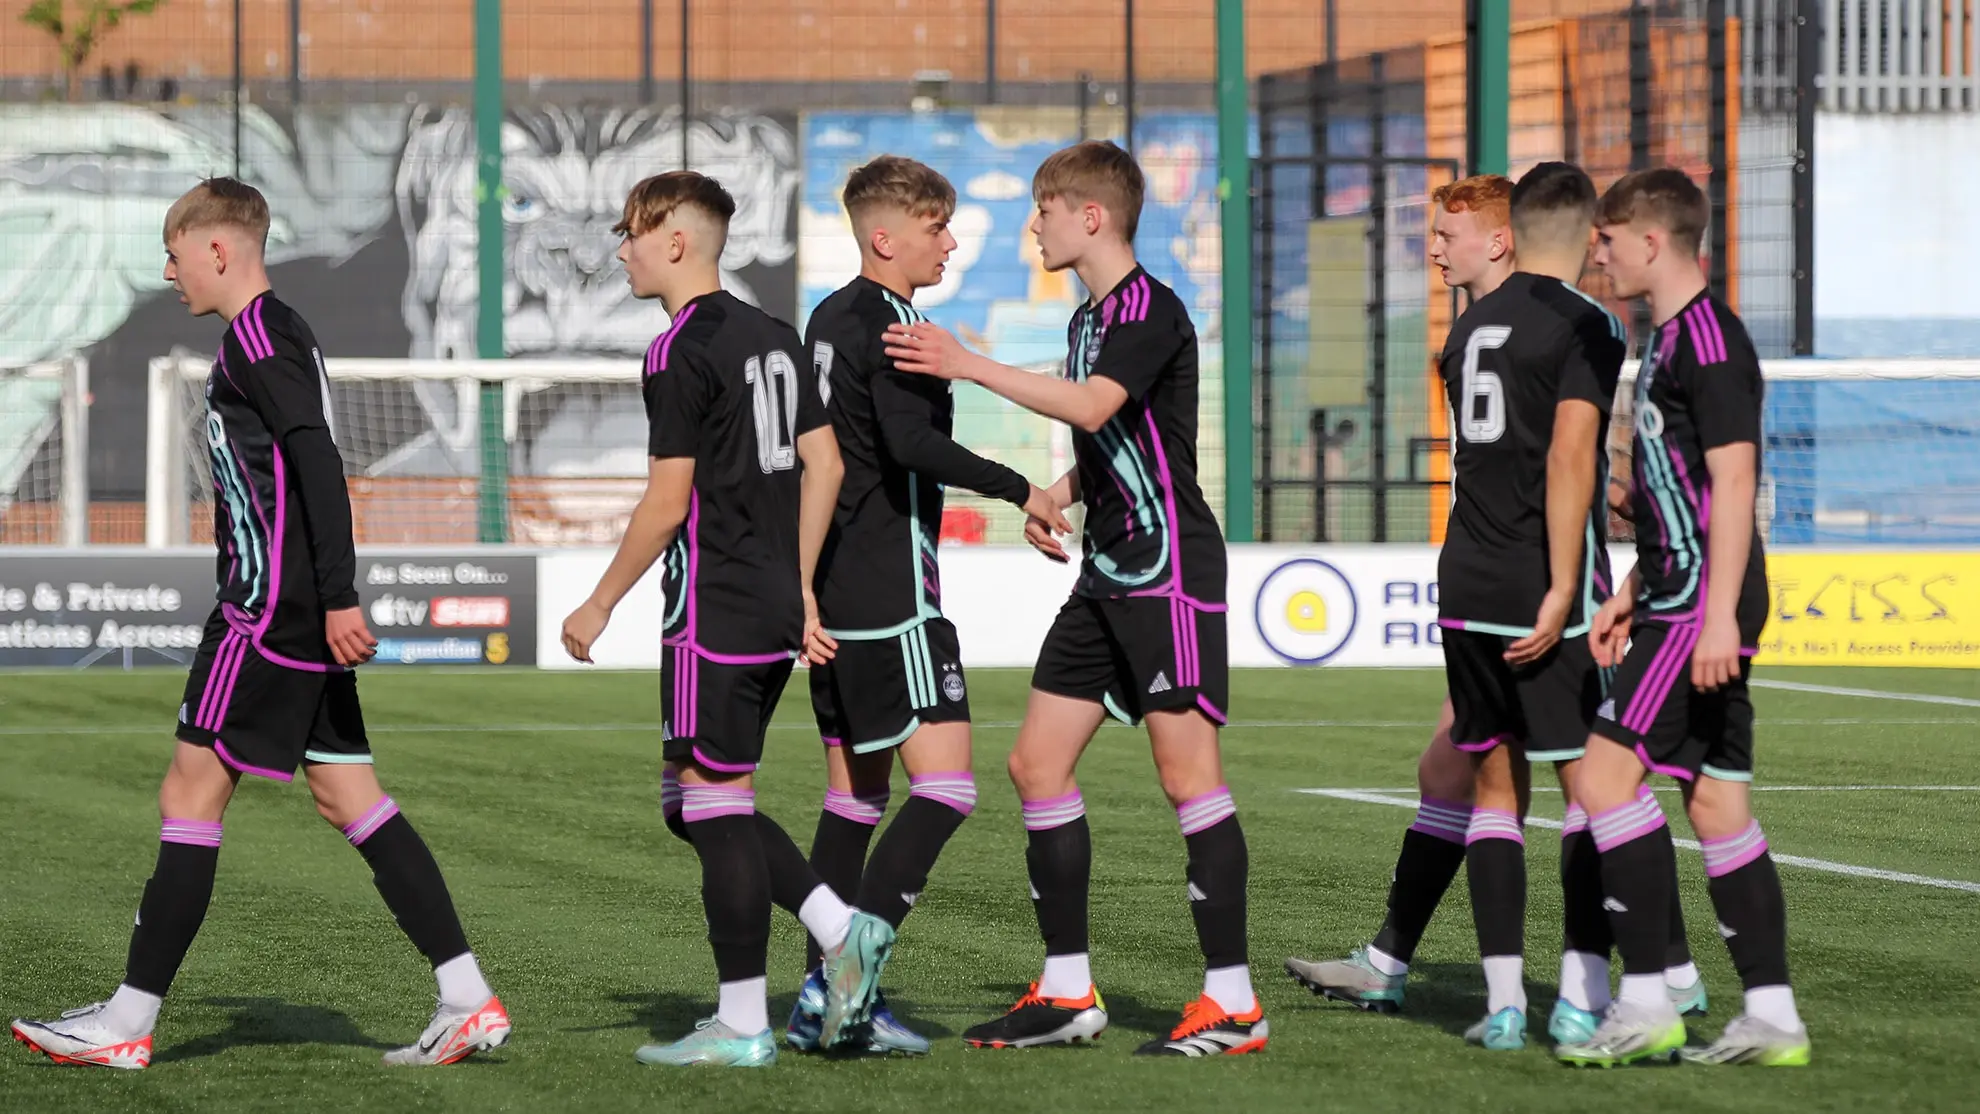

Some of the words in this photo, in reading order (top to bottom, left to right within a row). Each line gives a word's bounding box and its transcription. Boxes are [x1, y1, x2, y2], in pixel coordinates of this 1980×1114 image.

[1461, 325, 1512, 443] 6
[744, 350, 799, 474] 10
[367, 563, 397, 584] As
[399, 563, 452, 584] Seen
[66, 582, 182, 612] Private
[96, 619, 204, 648] Across
[1848, 640, 1903, 655] Access
